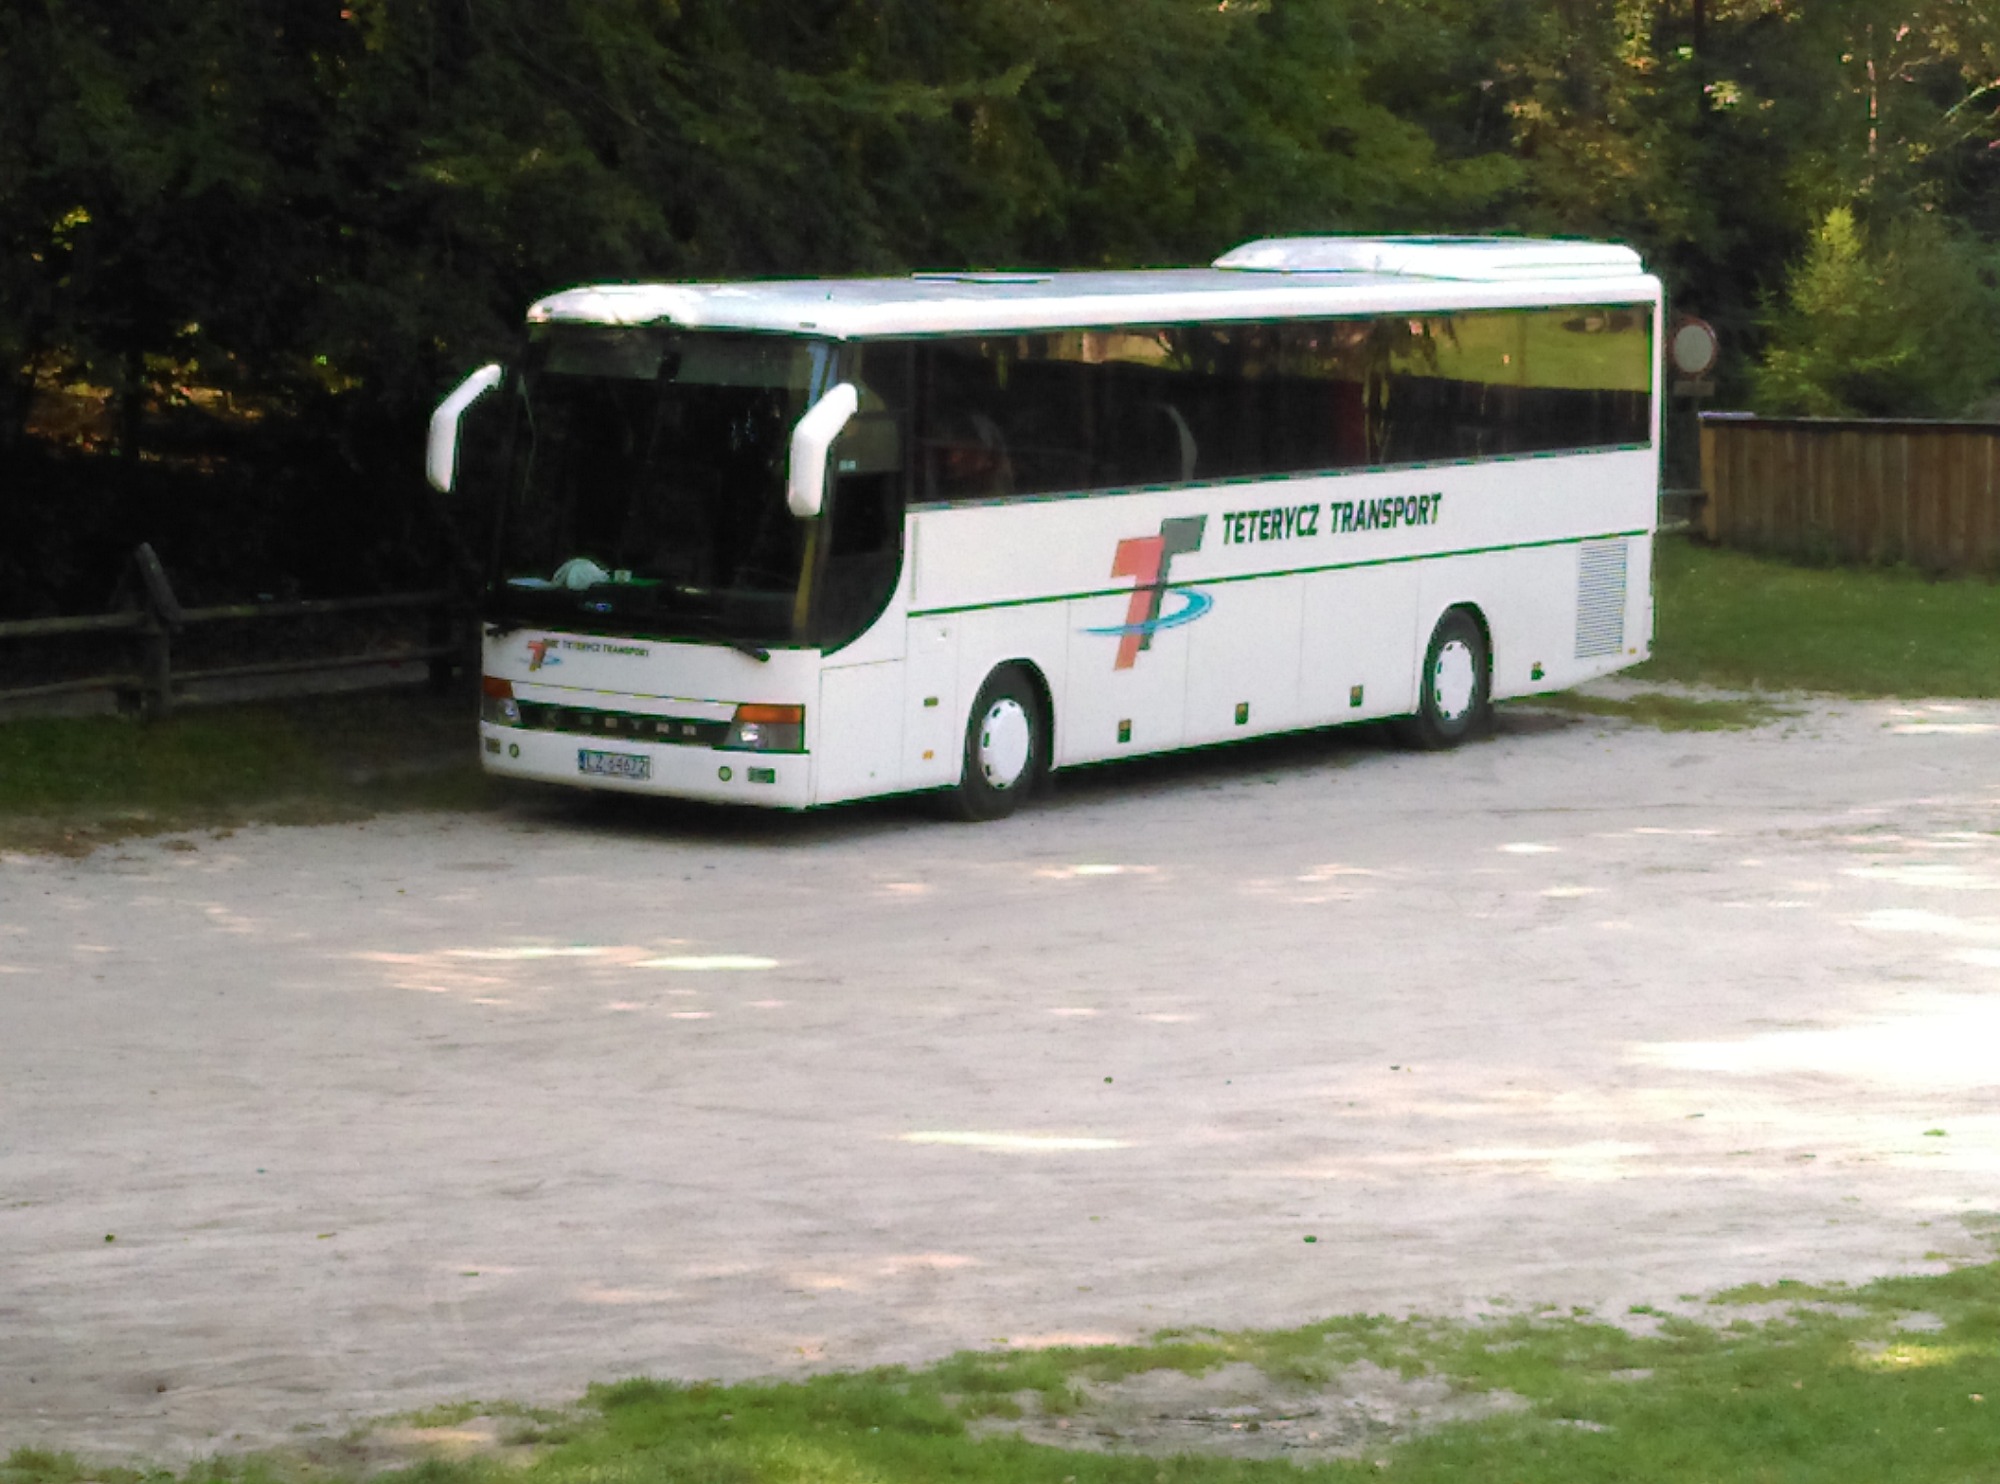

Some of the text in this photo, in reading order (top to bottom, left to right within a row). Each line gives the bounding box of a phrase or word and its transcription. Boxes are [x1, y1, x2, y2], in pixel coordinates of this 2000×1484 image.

[1223, 493, 1442, 545] TETERYCZ TRANSPORT
[603, 644, 649, 657] TRANSPORT
